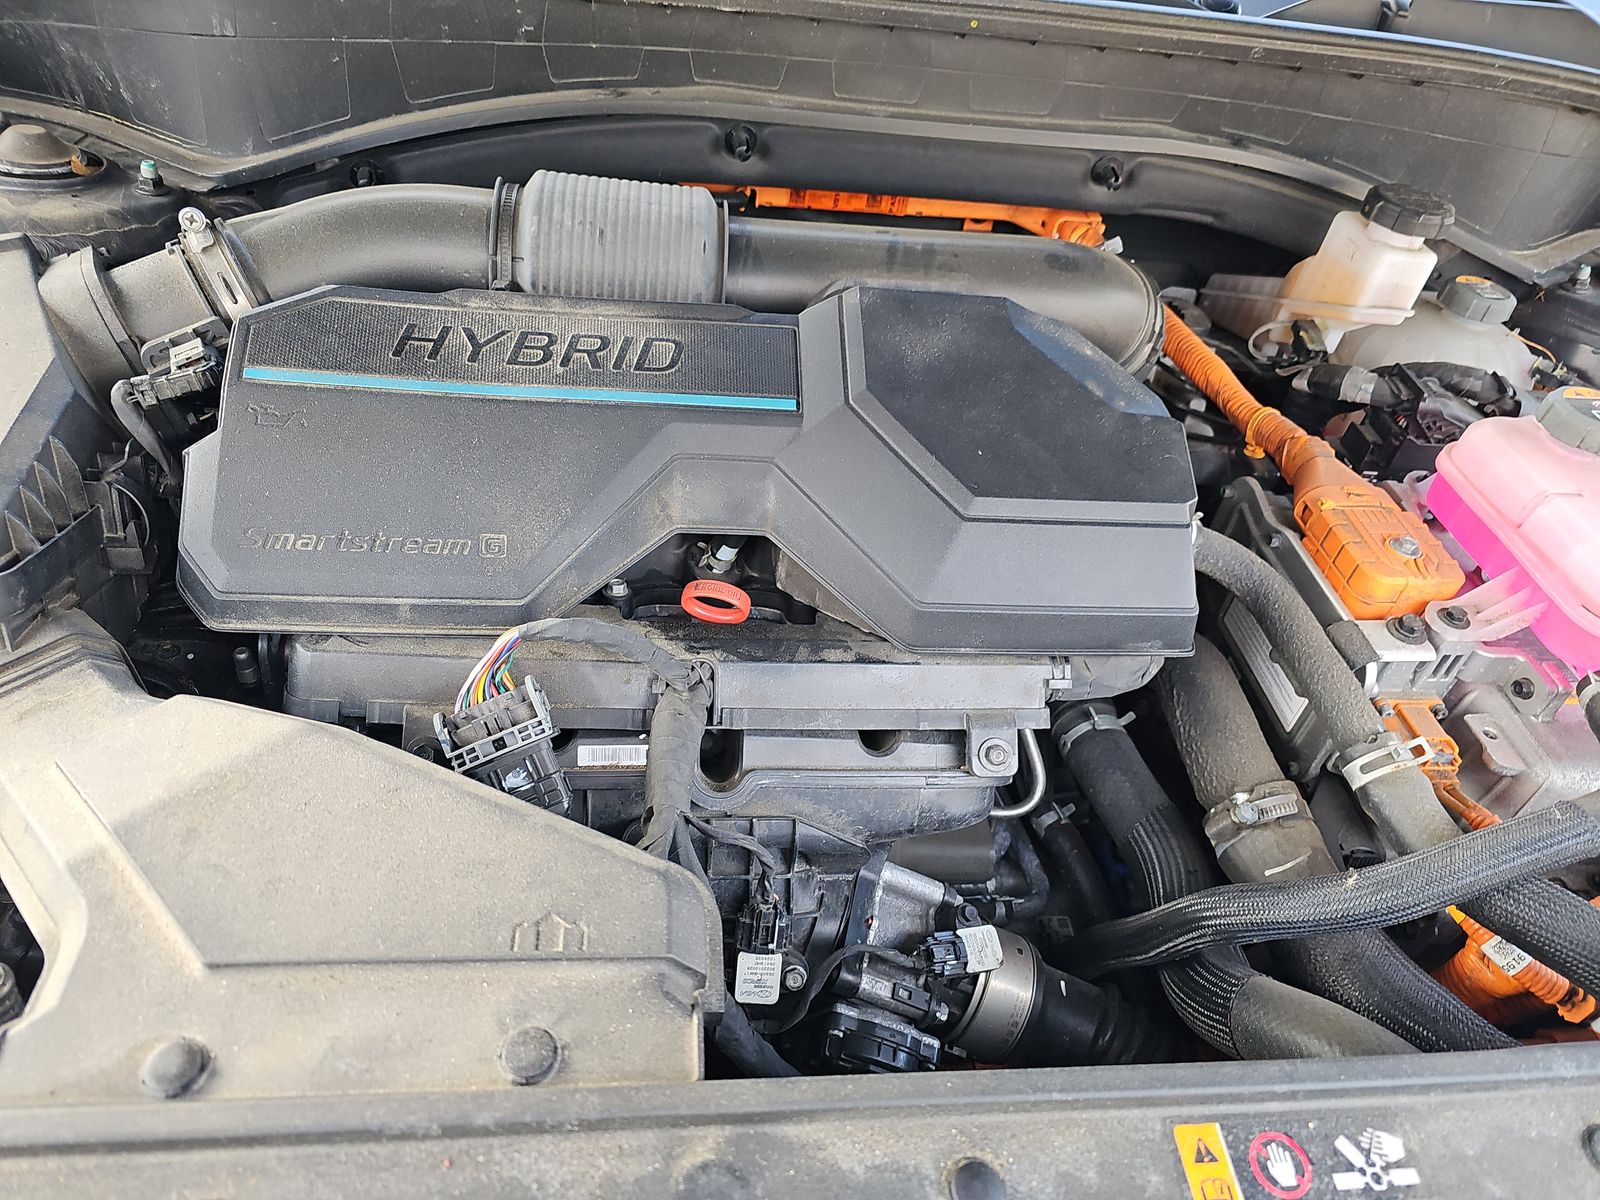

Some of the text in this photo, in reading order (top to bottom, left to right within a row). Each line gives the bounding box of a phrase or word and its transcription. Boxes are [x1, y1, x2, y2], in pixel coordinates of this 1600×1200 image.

[388, 323, 685, 373] HYBRID
[238, 527, 506, 557] Smartstream G
[1501, 952, 1526, 973] 9195
